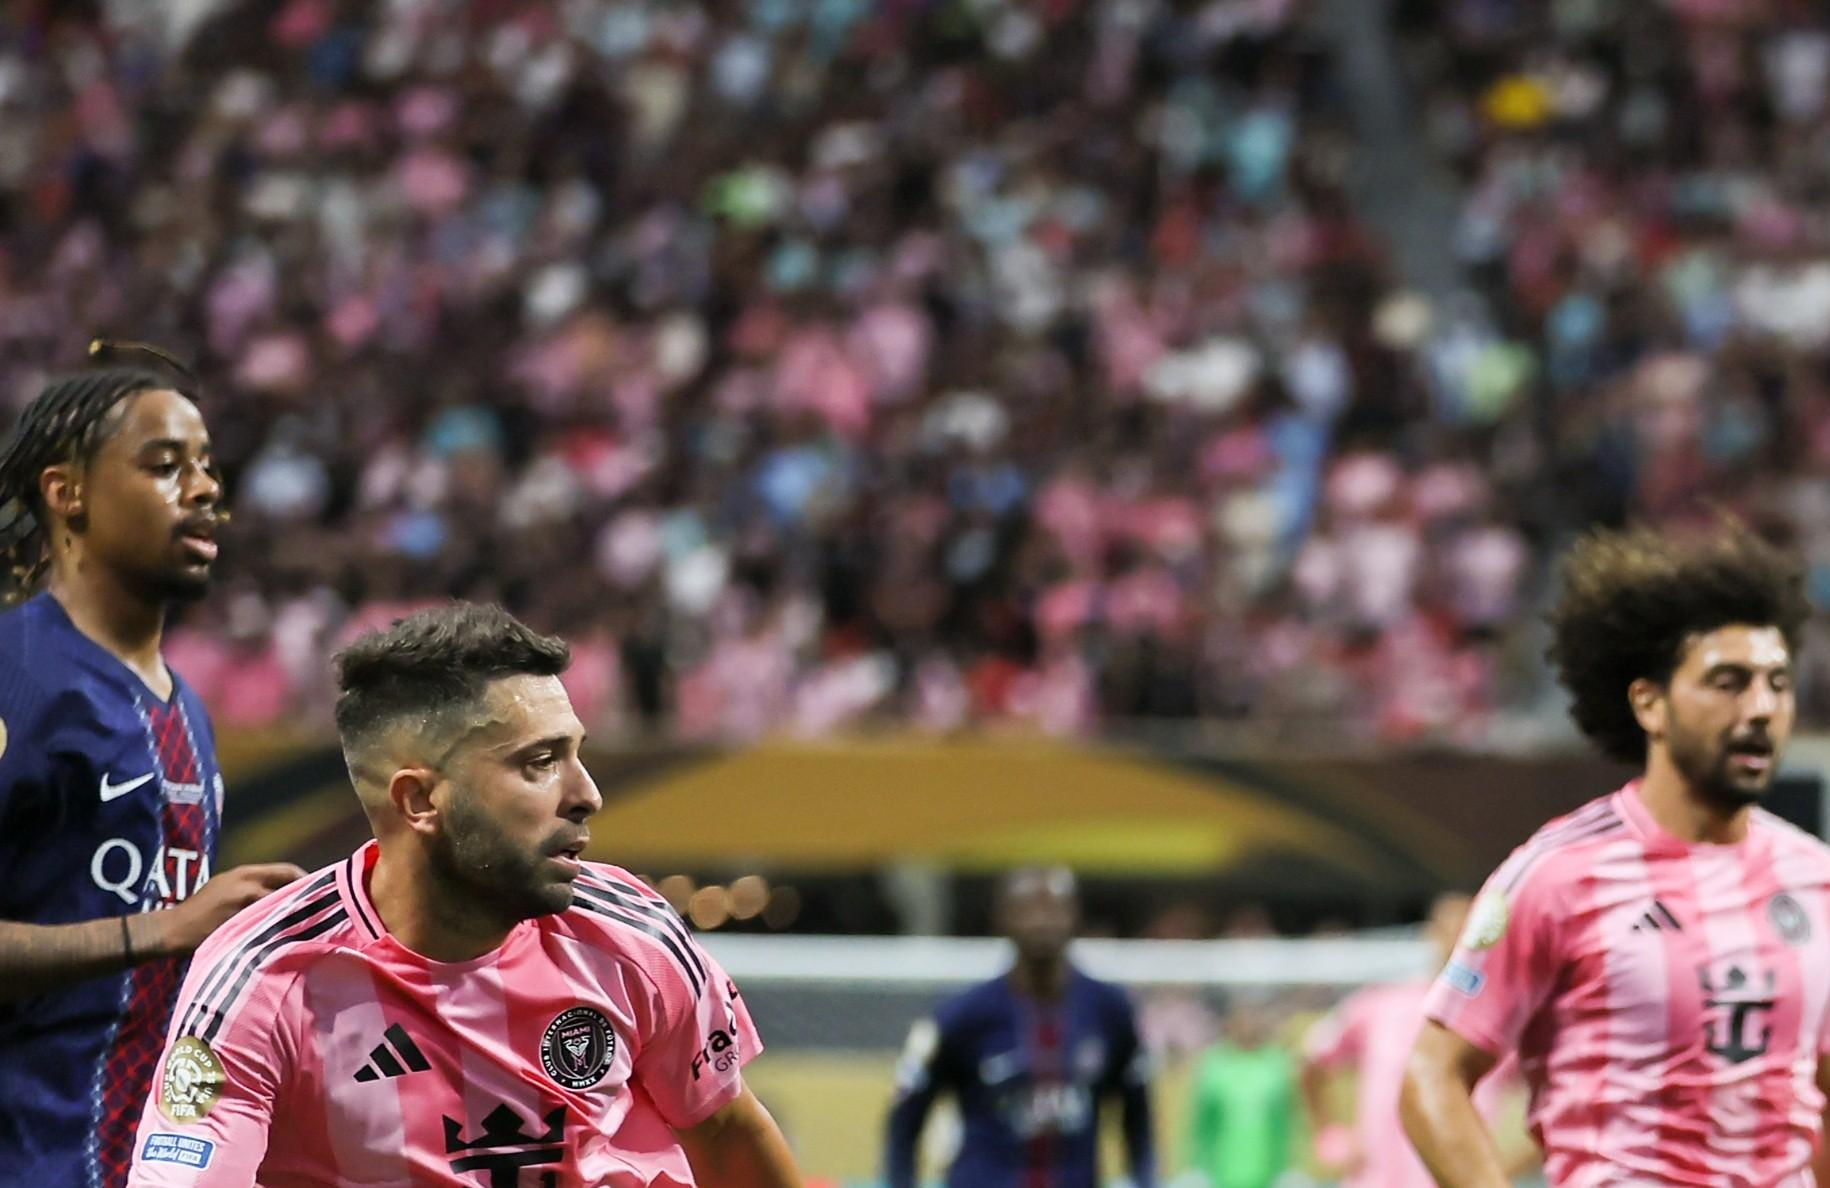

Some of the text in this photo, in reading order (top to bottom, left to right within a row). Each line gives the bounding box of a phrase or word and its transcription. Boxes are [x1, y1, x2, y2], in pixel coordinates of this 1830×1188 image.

[91, 838, 210, 904] QATA
[561, 1026, 591, 1039] MIAMI
[194, 1049, 213, 1068] CUP
